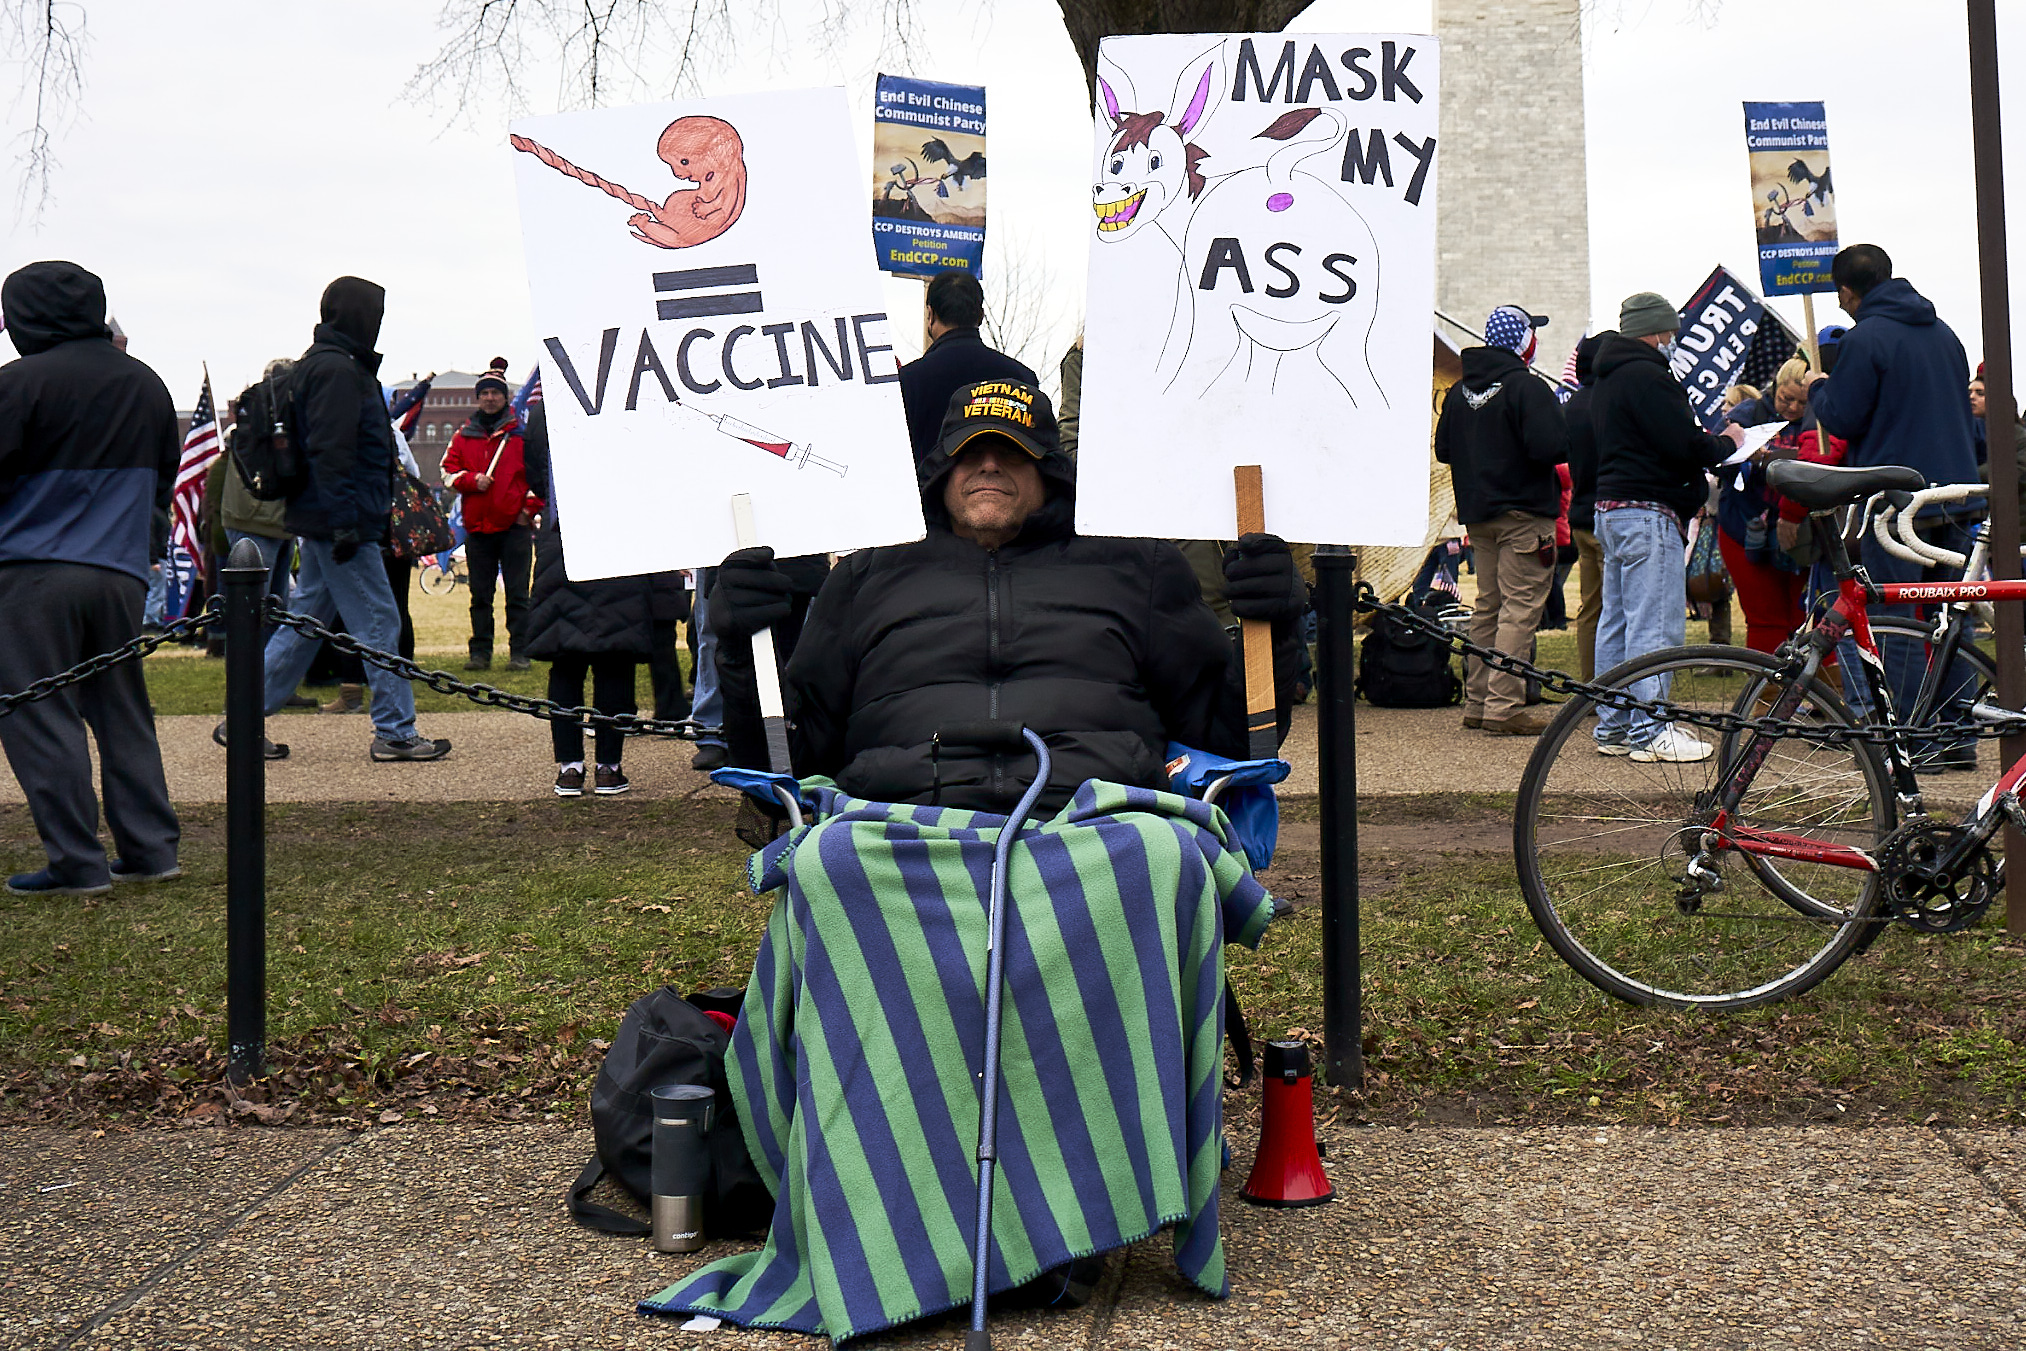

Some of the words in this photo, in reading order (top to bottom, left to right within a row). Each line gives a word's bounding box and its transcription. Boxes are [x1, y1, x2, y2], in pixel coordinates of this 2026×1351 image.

[1232, 38, 1423, 104] MASK
[880, 90, 906, 103] End
[908, 92, 931, 107] Evil
[933, 96, 983, 115] Chinese
[875, 105, 951, 127] Communist
[953, 115, 986, 134] Party
[1750, 118, 1770, 131] End
[1771, 117, 1789, 131] Evil
[1790, 117, 1828, 130] Chinese
[1747, 134, 1807, 147] Communist
[1807, 134, 1829, 147] Part
[1341, 128, 1437, 207] MY
[874, 222, 894, 233] CCP
[895, 224, 941, 238] DESTROYS
[942, 229, 984, 243] AMERICA
[912, 238, 948, 250] Petition
[1760, 249, 1777, 260] CCP
[1778, 247, 1814, 258] DESTROYS
[889, 248, 968, 268] EndCCP.com
[1199, 238, 1358, 304] ASS
[543, 312, 901, 416] VACCINE
[970, 383, 1034, 406] VIETNAM
[963, 403, 1033, 428] VETERAN
[1898, 587, 1958, 599] ROUBAIX
[1959, 585, 1987, 597] PRO
[672, 1231, 697, 1240] contigo
